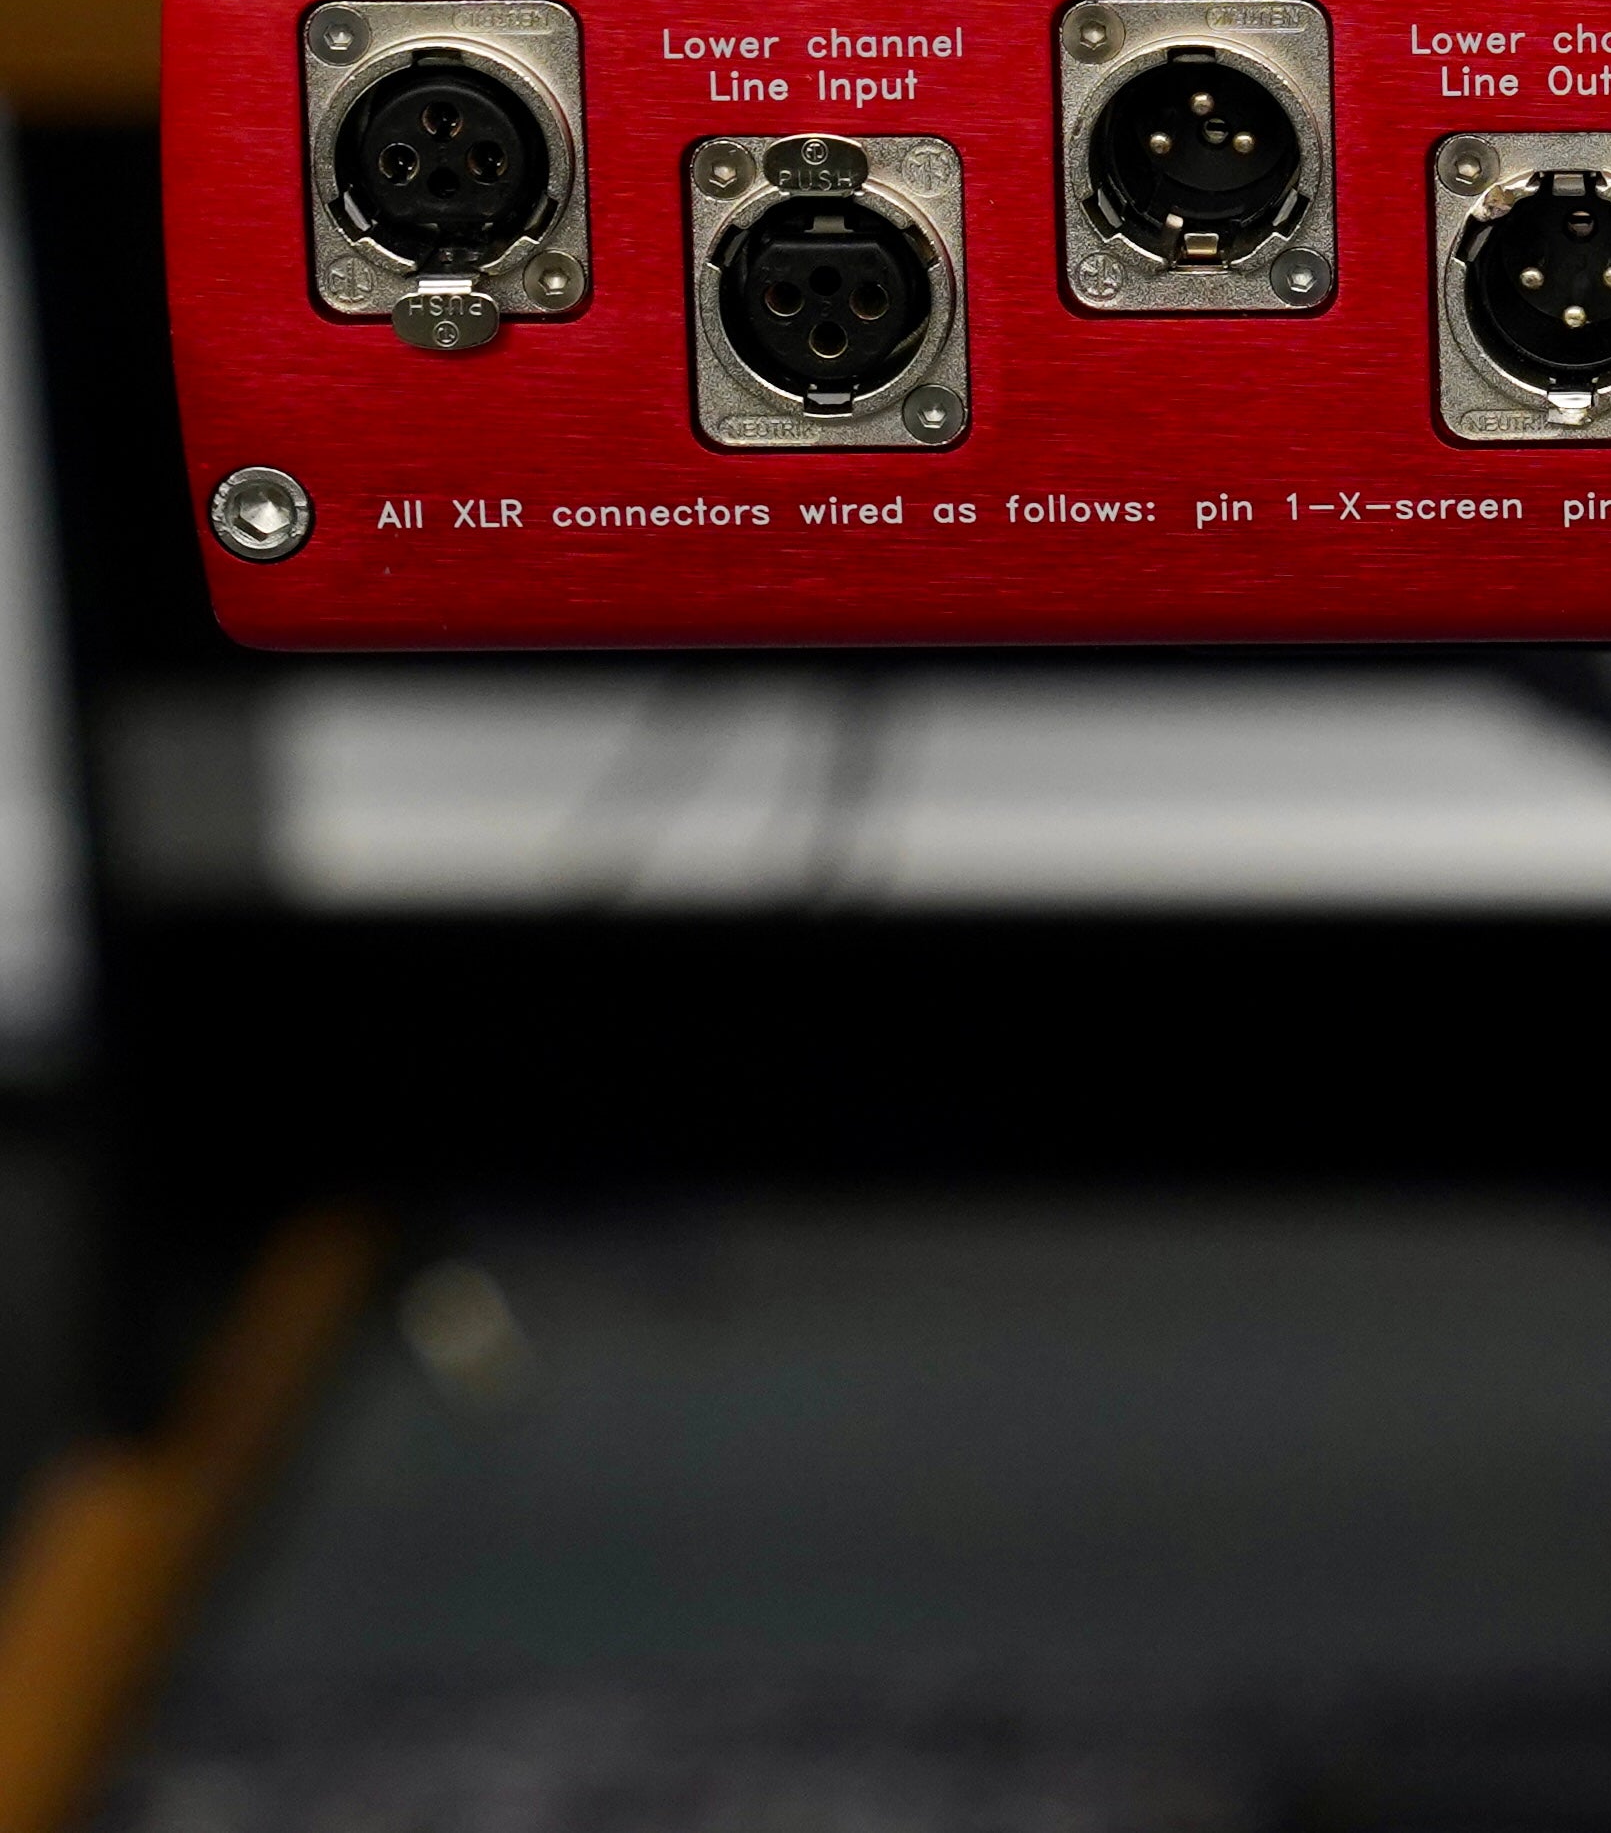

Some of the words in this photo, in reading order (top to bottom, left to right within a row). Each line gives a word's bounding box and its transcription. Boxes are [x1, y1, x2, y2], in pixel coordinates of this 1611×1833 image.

[663, 28, 780, 60] Lower
[807, 26, 963, 59] channel
[1411, 23, 1526, 55] Lower
[710, 70, 789, 102] Line
[818, 69, 918, 106] Input
[1441, 65, 1519, 97] Line
[777, 168, 855, 192] PUSH
[409, 296, 483, 318] PUSH
[377, 499, 423, 529] All
[452, 498, 523, 528] XLR
[552, 497, 770, 528] connectors
[799, 495, 903, 525] wired
[933, 503, 977, 524] as
[1005, 494, 1156, 523] follows:
[1196, 492, 1253, 530] pin
[1286, 491, 1523, 521] 1-X-screen
